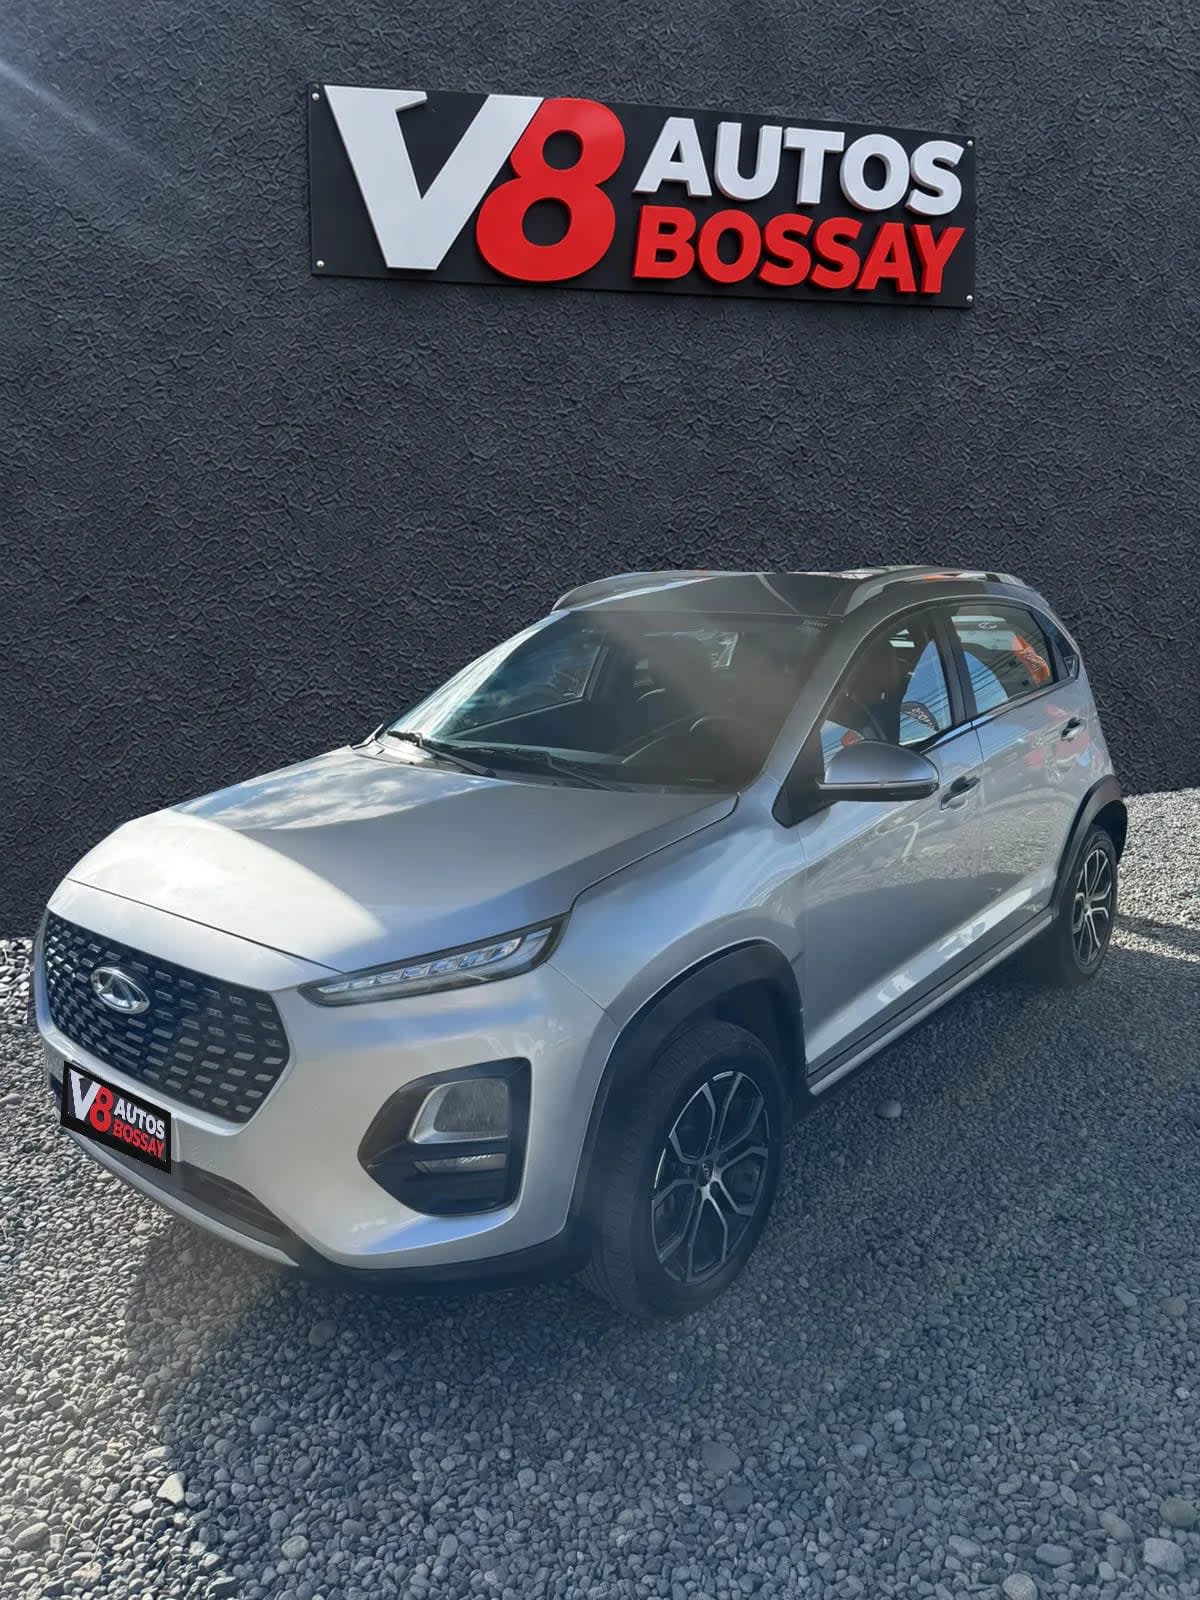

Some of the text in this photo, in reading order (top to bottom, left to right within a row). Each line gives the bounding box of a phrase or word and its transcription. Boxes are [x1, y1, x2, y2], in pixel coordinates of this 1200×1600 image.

[633, 116, 965, 216] AUTOS
[632, 204, 965, 293] BOSSAY
[114, 1098, 165, 1140] AUTOS
[114, 1119, 165, 1158] BOSSAY
